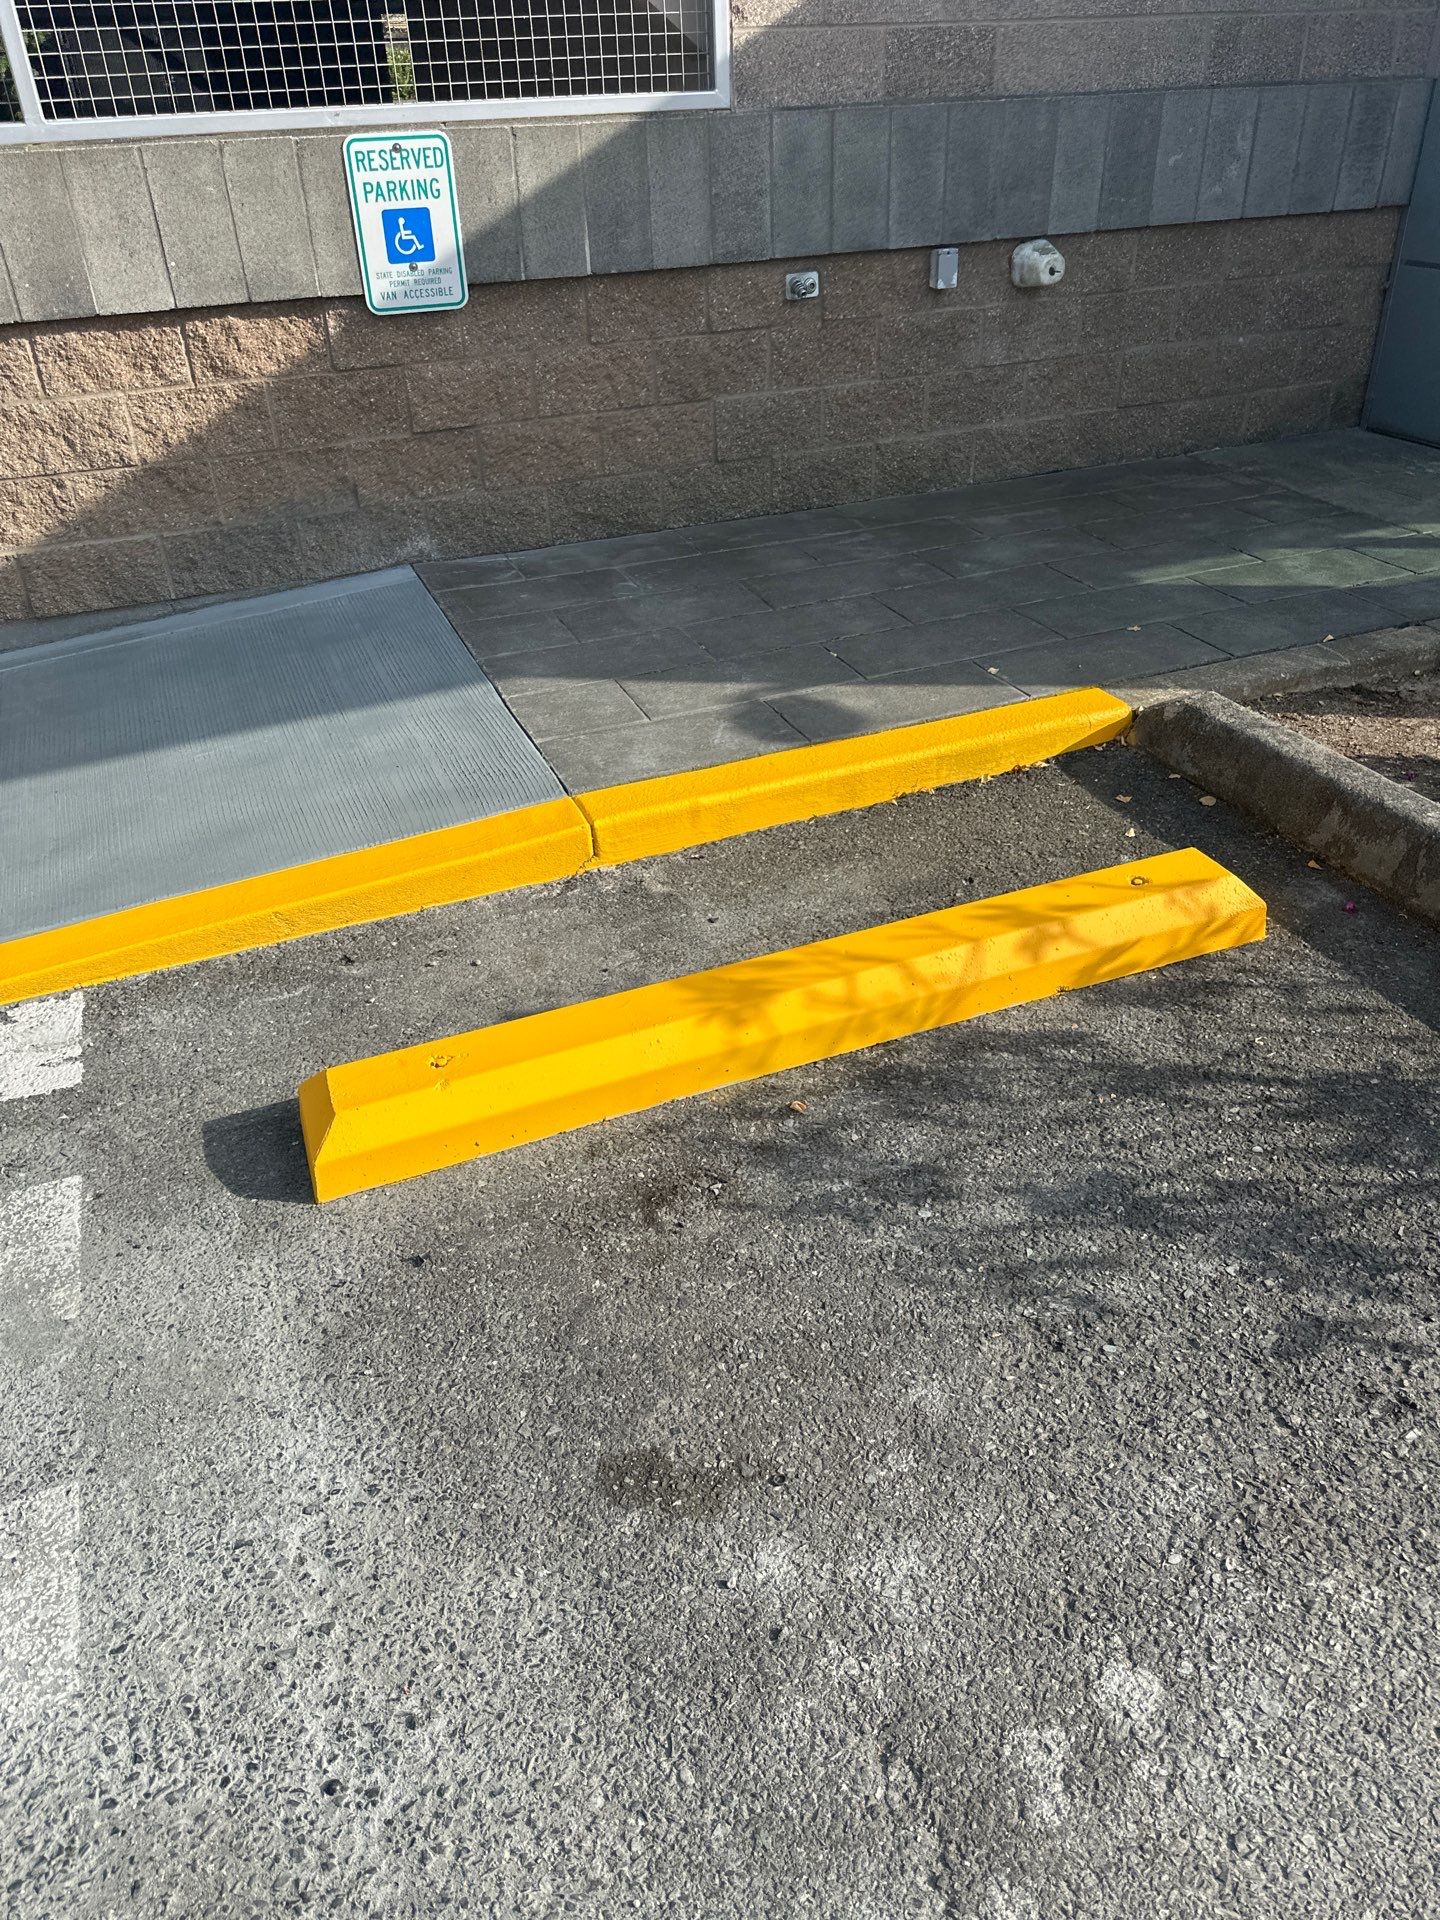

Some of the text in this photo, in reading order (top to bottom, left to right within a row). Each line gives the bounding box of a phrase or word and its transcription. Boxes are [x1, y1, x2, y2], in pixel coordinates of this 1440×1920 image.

[354, 147, 444, 172] RESERVED
[363, 178, 441, 203] PARKING
[376, 267, 453, 280] STATE DISABLED PARKING
[389, 277, 442, 288] PERMIT REQUIRED
[380, 286, 454, 301] VAN ACCESSIBLE
